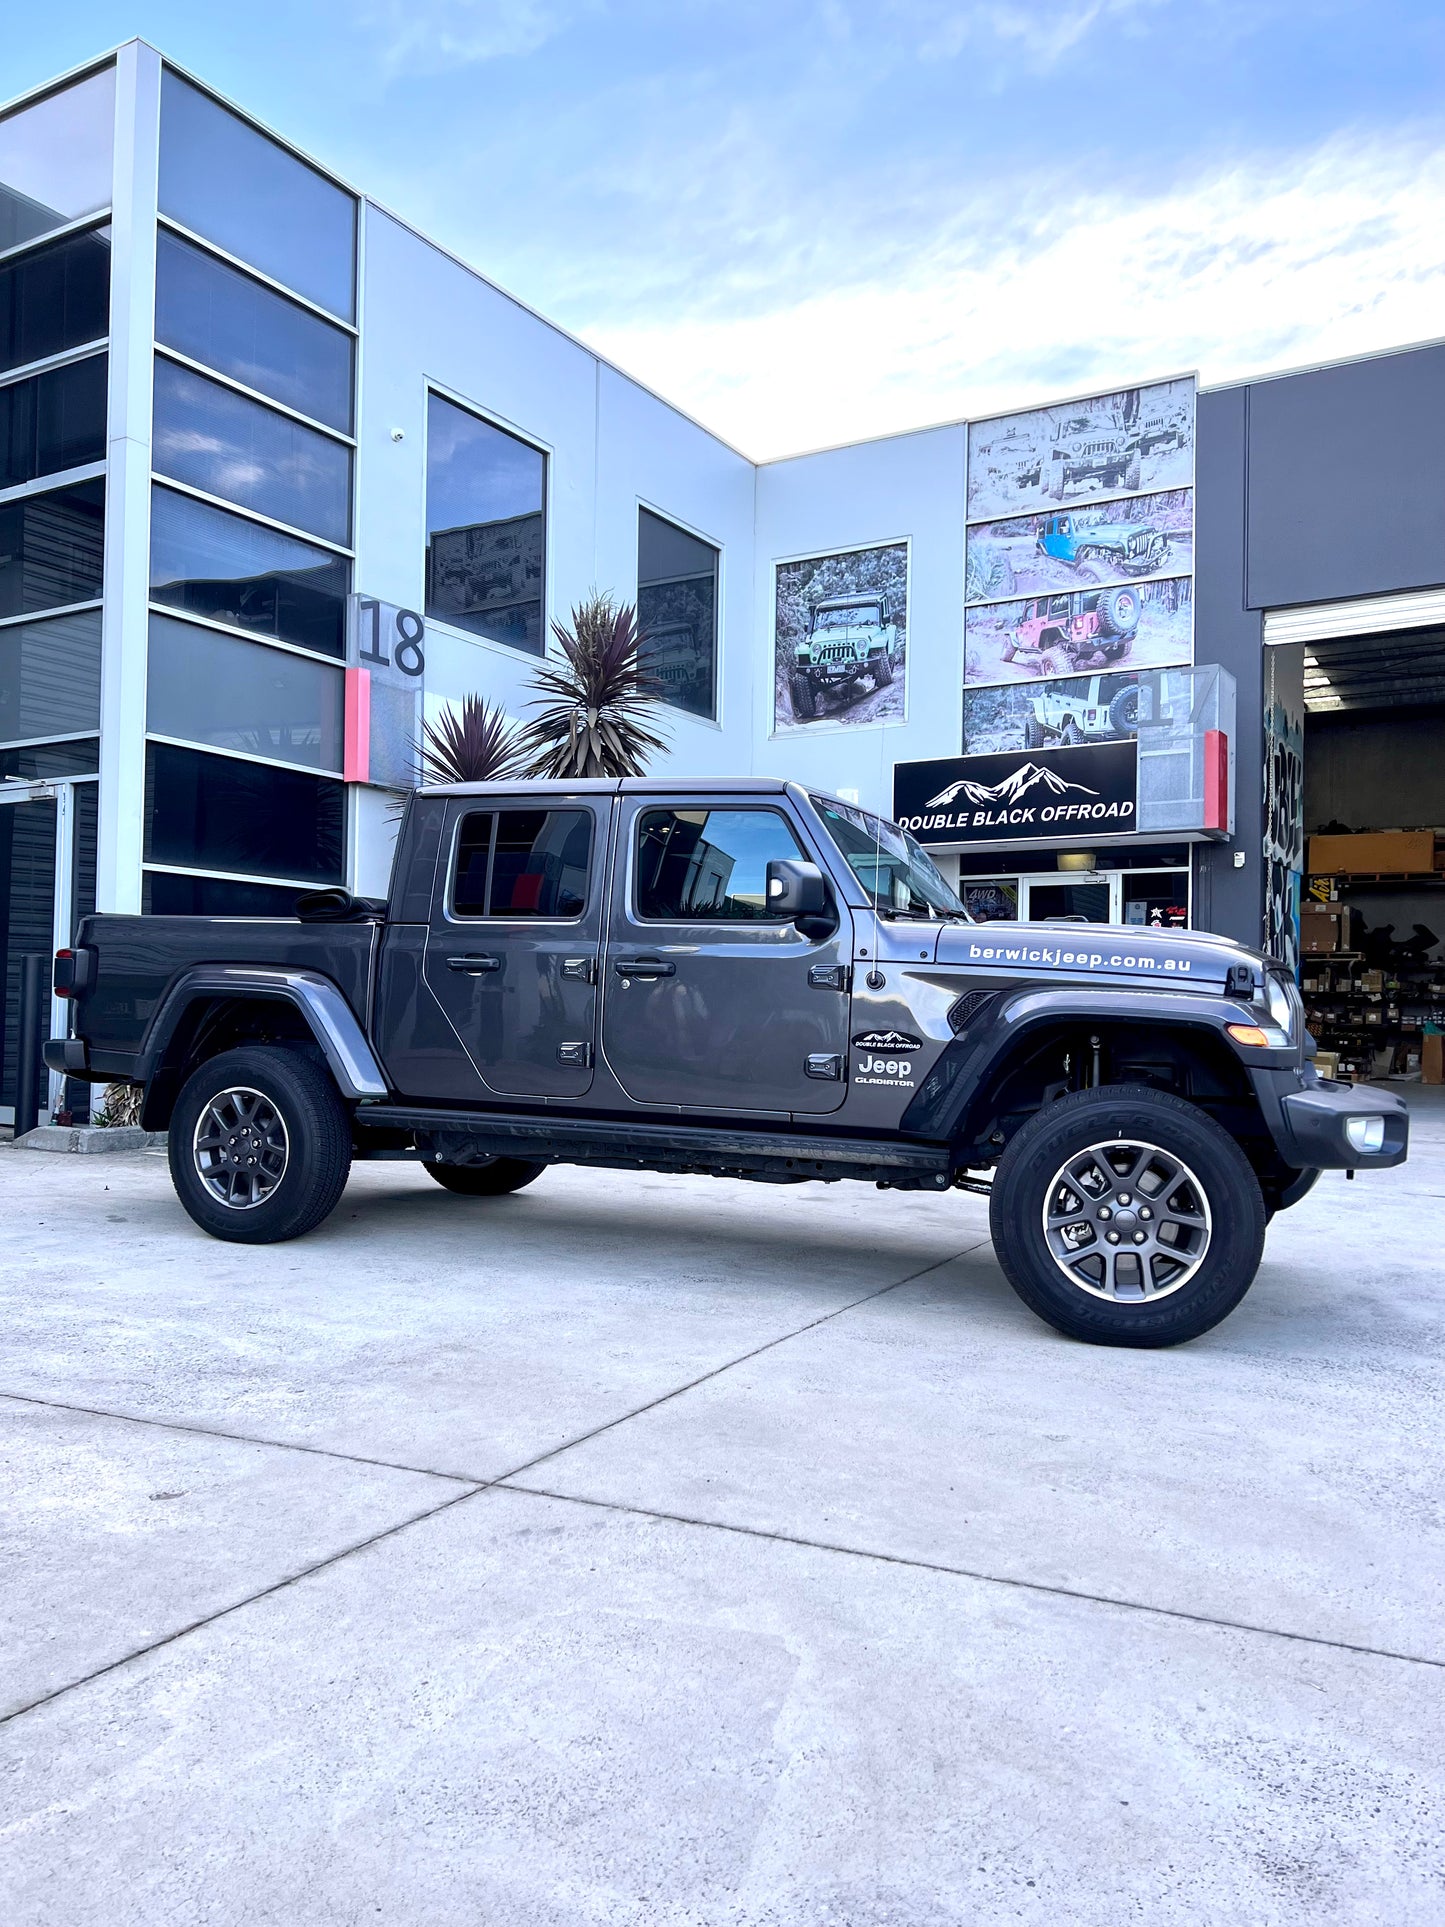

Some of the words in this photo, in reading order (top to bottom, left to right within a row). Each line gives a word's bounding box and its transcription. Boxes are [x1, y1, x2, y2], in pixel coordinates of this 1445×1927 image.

[360, 600, 425, 676] 18
[1138, 664, 1219, 727] 17
[898, 812, 969, 831] DOUBLE
[972, 807, 1037, 826] BLACK
[1040, 801, 1134, 822] OFFROAD
[969, 944, 1191, 972] berwickjeep.com.au
[858, 1055, 912, 1078] Jeep
[854, 1077, 914, 1087] GLADIATOR
